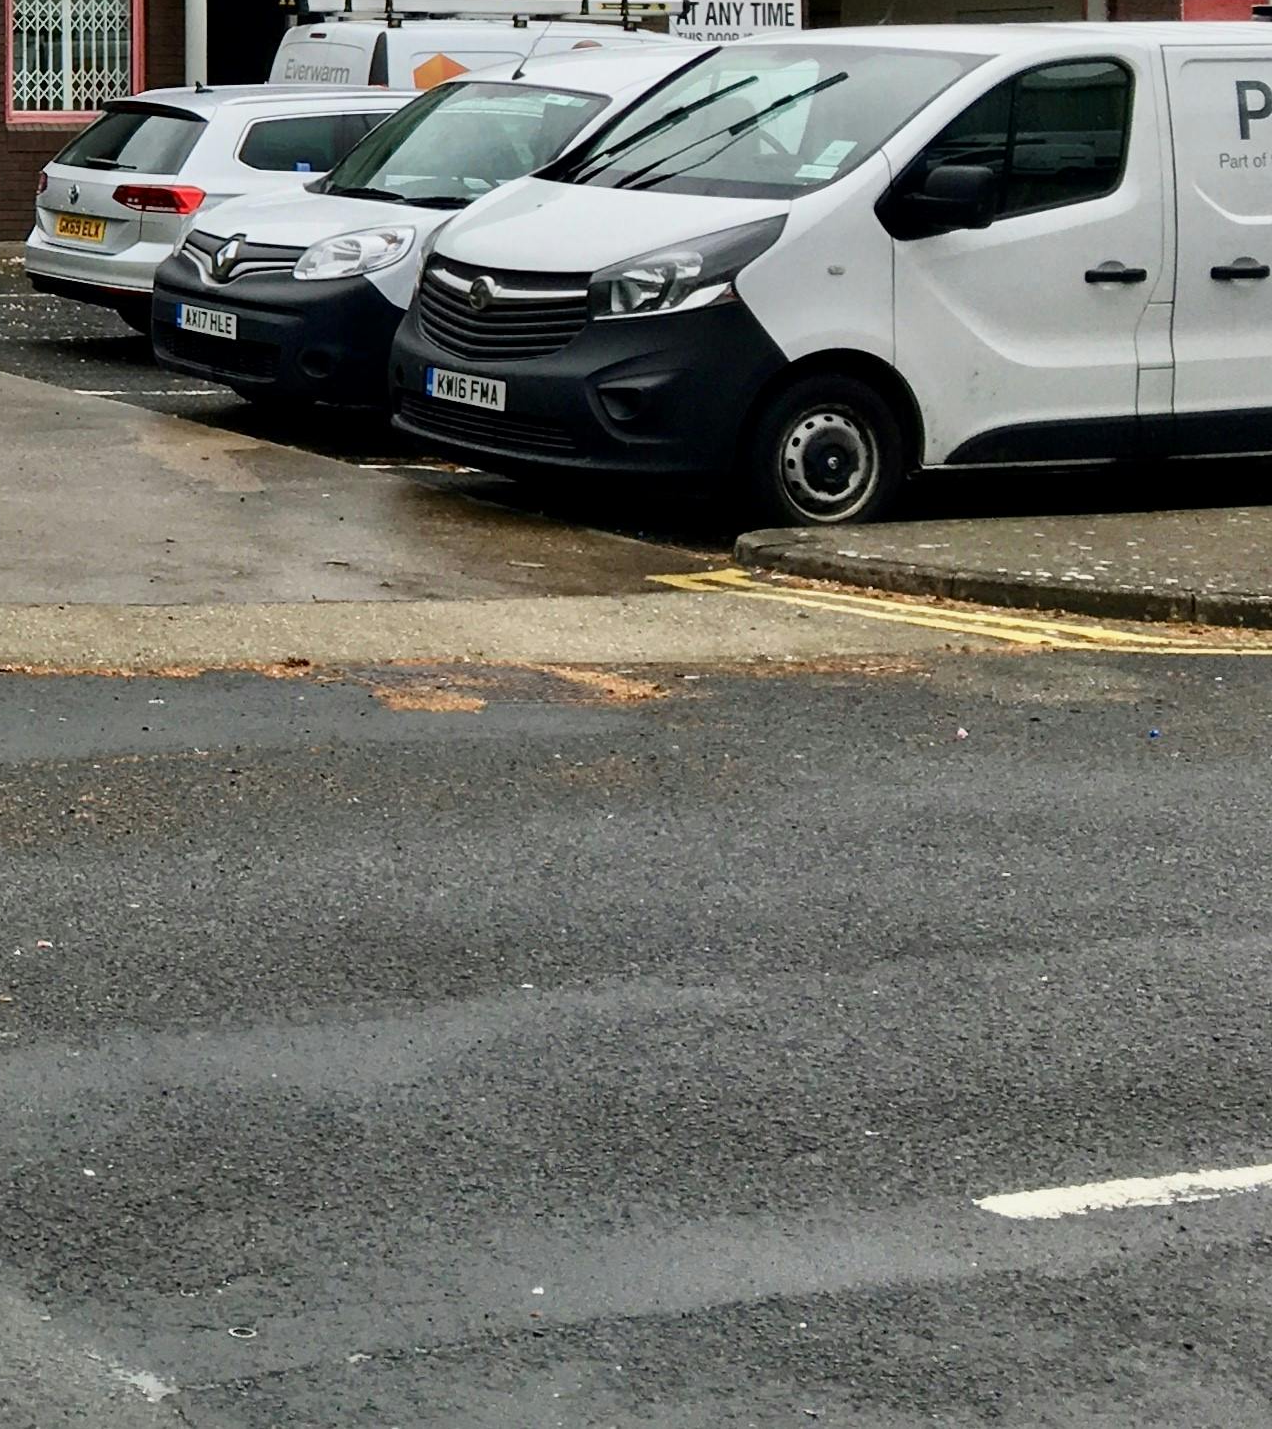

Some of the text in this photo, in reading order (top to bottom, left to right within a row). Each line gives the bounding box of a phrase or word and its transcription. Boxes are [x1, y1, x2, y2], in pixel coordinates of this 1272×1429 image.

[705, 2, 744, 25] ANY
[750, 3, 795, 27] TIME
[285, 58, 350, 84] Everwarm
[1219, 153, 1249, 169] Part
[1253, 152, 1267, 169] of
[185, 311, 207, 329] AX17
[210, 313, 232, 335] HLE
[437, 374, 466, 399] KW16
[471, 380, 498, 406] FMA
